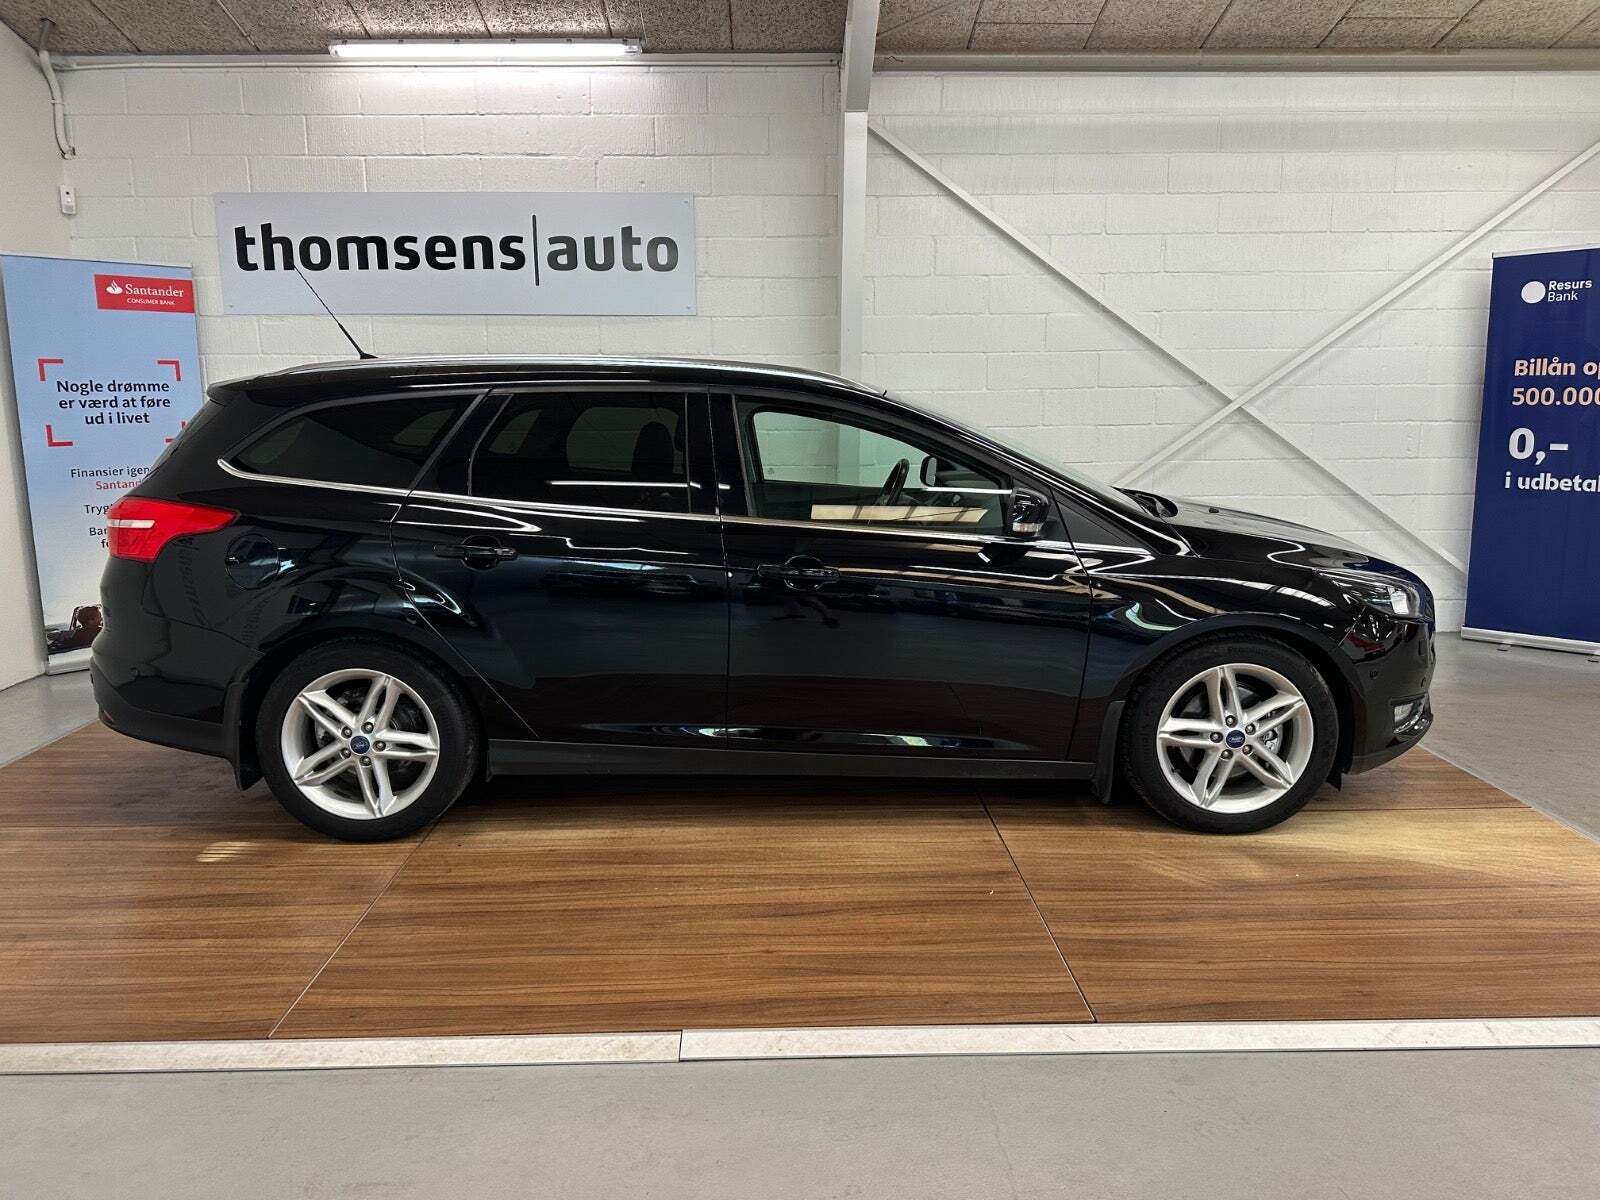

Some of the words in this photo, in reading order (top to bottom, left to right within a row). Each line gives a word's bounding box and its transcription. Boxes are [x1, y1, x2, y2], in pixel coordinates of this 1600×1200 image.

[234, 222, 527, 272] thomsens
[546, 225, 679, 272] auto
[125, 283, 185, 298] Santander
[1548, 280, 1593, 291] Resurs
[126, 297, 159, 305] CONSUMER
[1547, 290, 1579, 302] Bank
[1514, 356, 1576, 376] Billån
[1583, 361, 1600, 380] o
[56, 379, 104, 396] Nogle
[107, 379, 170, 393] drømme
[58, 399, 75, 409] er
[78, 396, 119, 409] værd
[122, 397, 138, 408] at
[140, 395, 171, 409] føre
[84, 412, 105, 425] ud
[108, 412, 114, 424] i
[116, 412, 151, 424] livet
[70, 466, 124, 478] Finansier
[1504, 471, 1512, 489] i
[83, 503, 113, 516] Tryg
